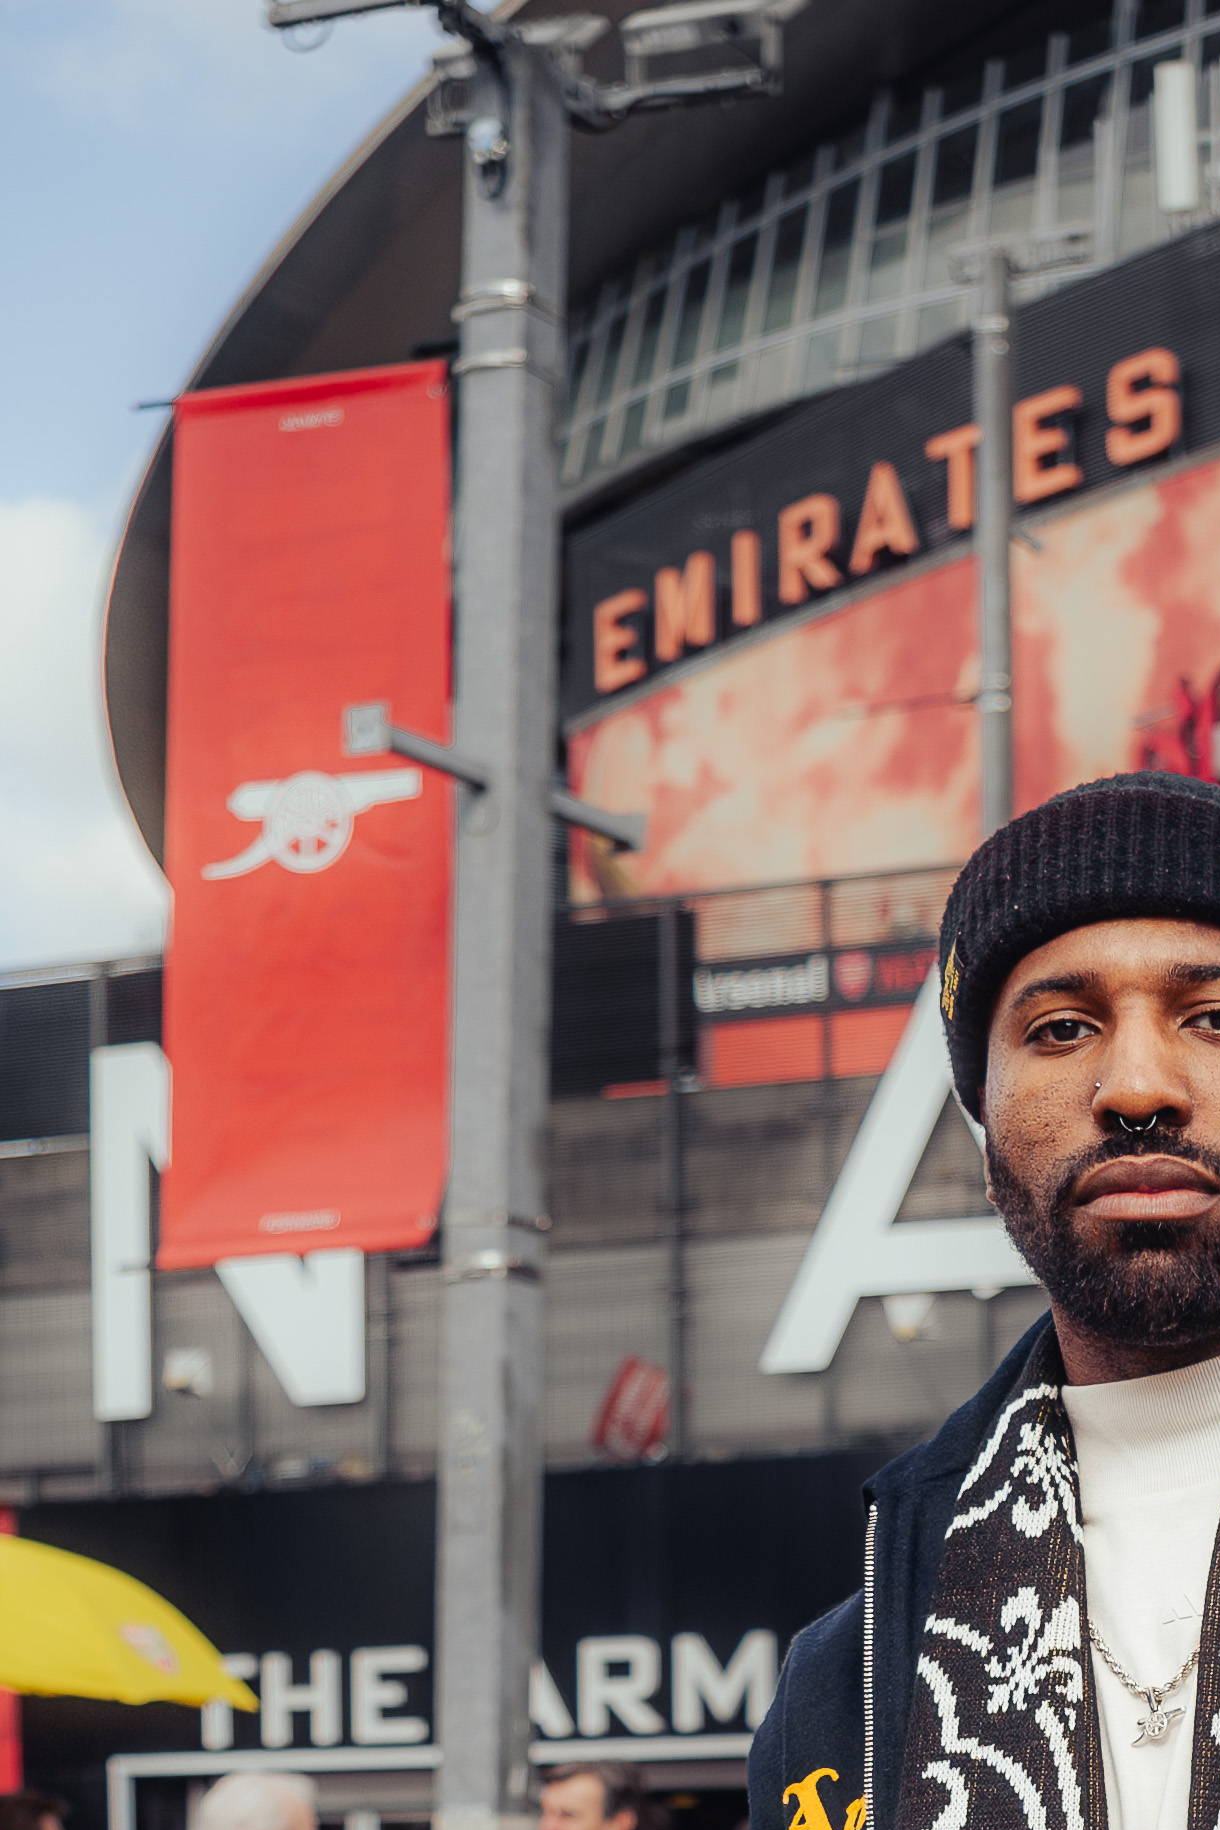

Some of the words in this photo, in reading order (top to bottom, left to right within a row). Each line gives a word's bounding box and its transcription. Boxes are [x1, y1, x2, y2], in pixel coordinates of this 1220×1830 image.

[593, 345, 1183, 693] EMIRATES
[692, 953, 830, 1013] rsenal
[201, 1644, 431, 1751] THE
